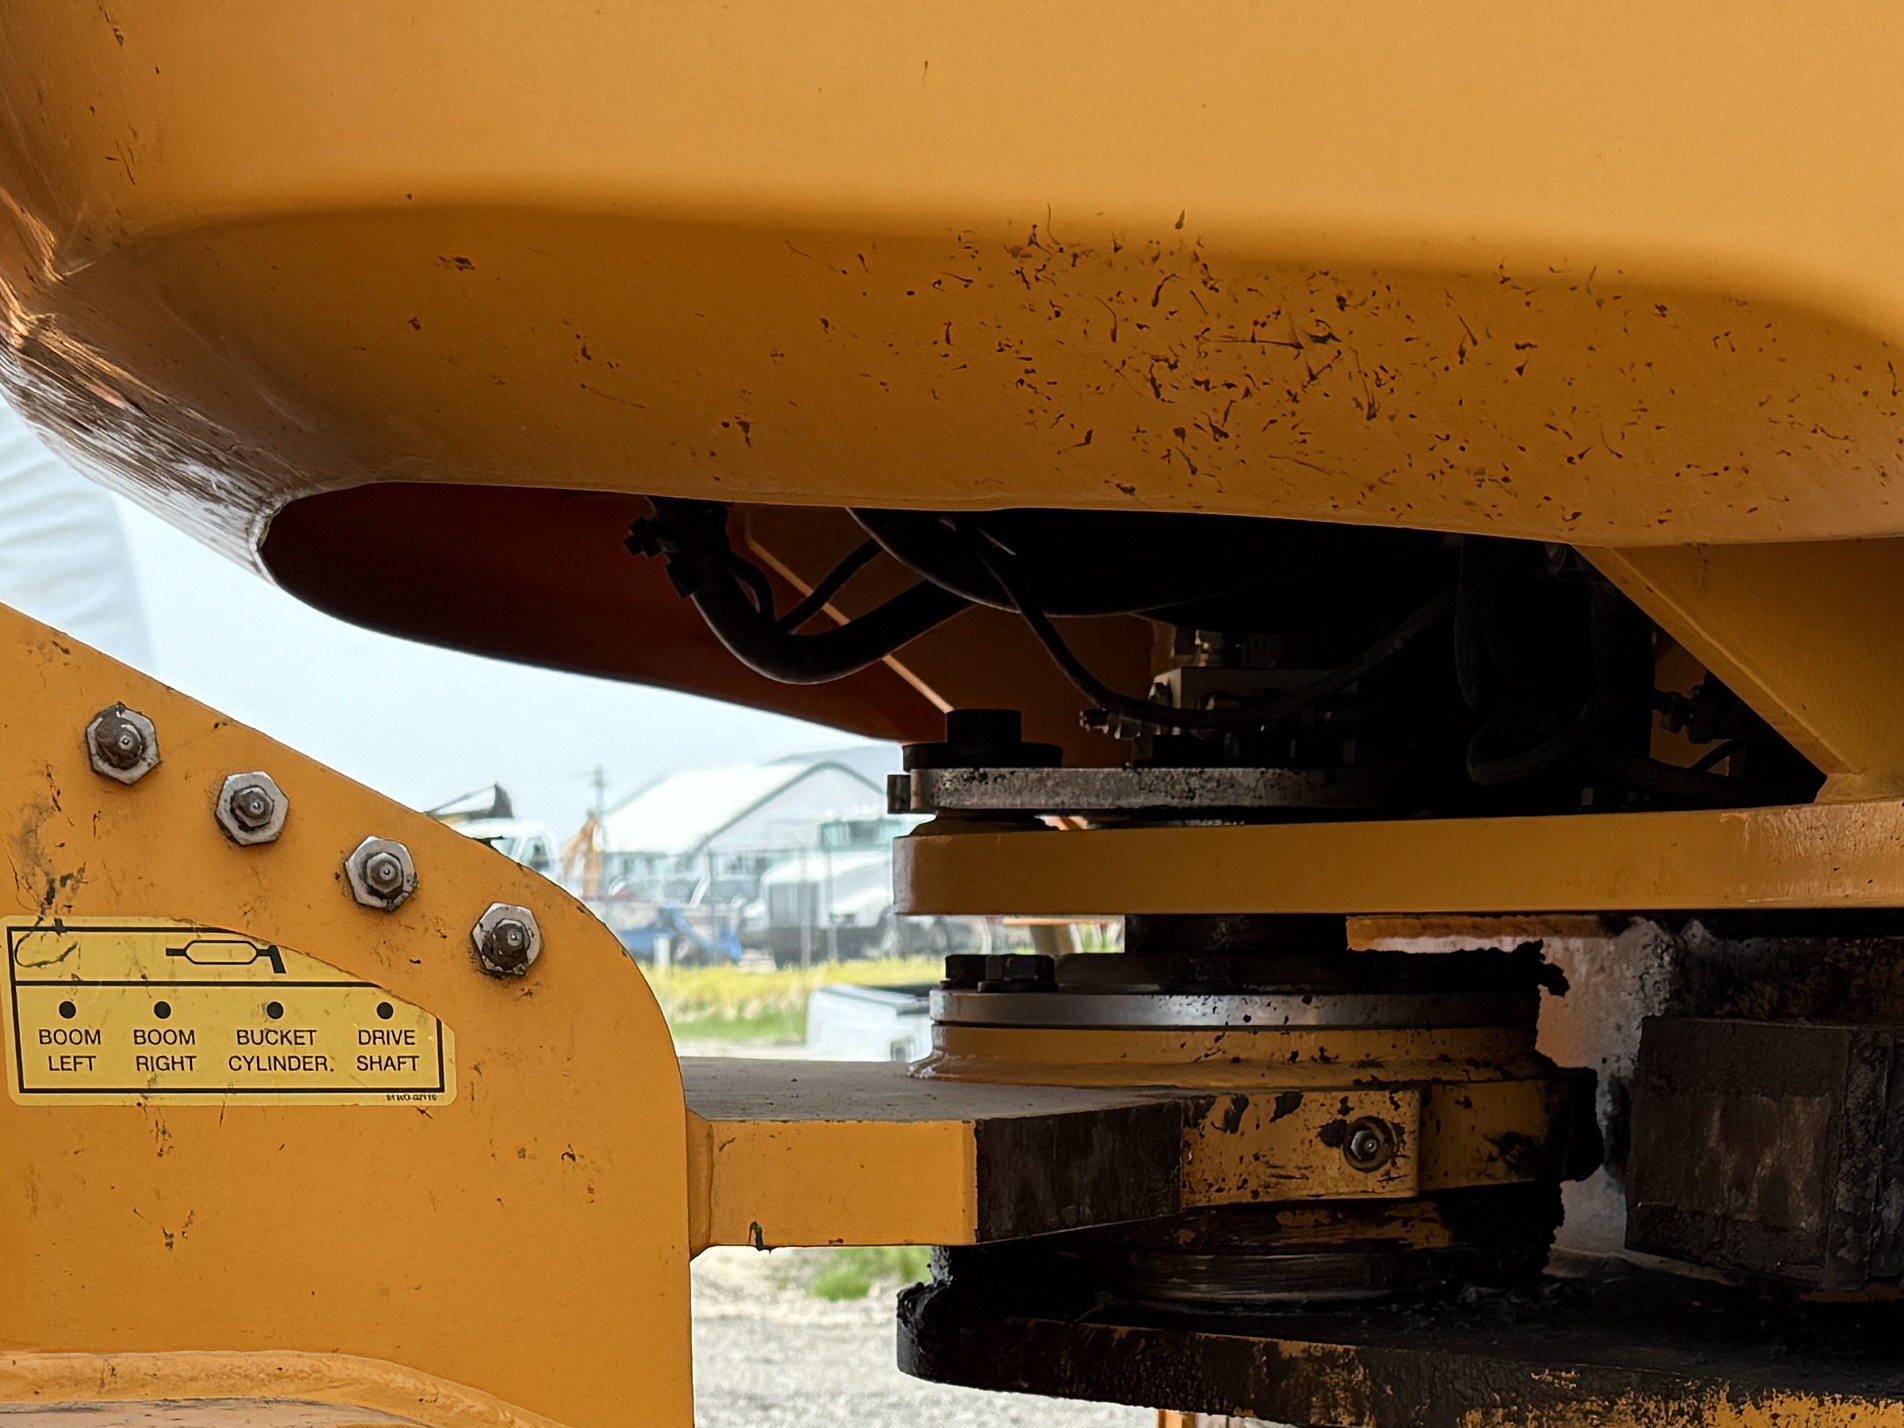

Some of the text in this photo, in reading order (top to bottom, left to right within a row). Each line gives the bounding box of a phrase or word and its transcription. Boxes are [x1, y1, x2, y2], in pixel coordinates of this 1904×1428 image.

[39, 1028, 415, 1045] BOOM BOOM BUCKET DRIVE
[48, 1056, 96, 1071] LEFT
[136, 1056, 197, 1072] RIGHT
[357, 1056, 419, 1071] SHAFT
